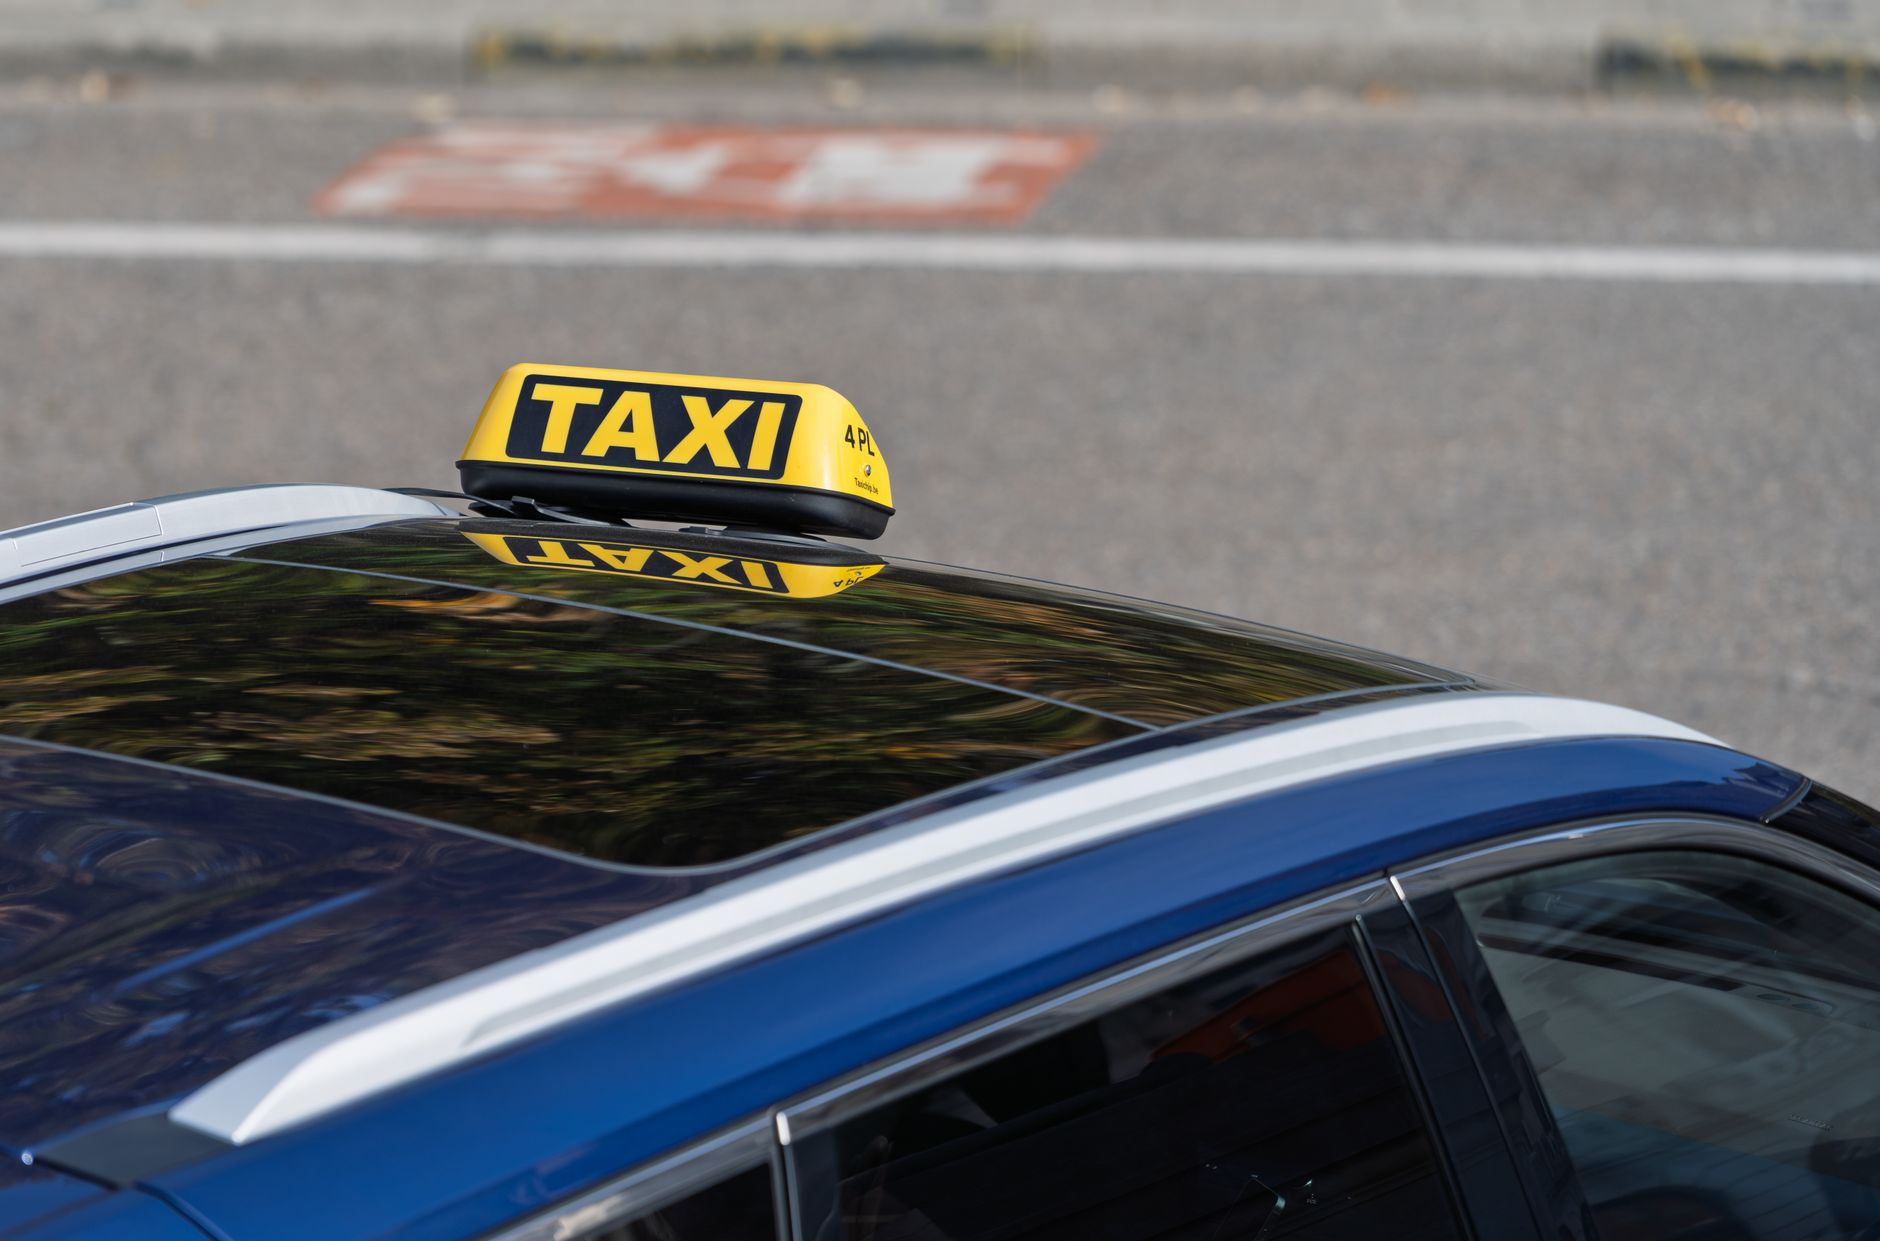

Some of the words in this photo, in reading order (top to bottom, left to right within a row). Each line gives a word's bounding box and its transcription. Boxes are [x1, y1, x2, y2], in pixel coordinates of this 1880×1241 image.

[531, 382, 787, 471] TAXI
[844, 424, 856, 449] 4
[857, 426, 875, 457] PL
